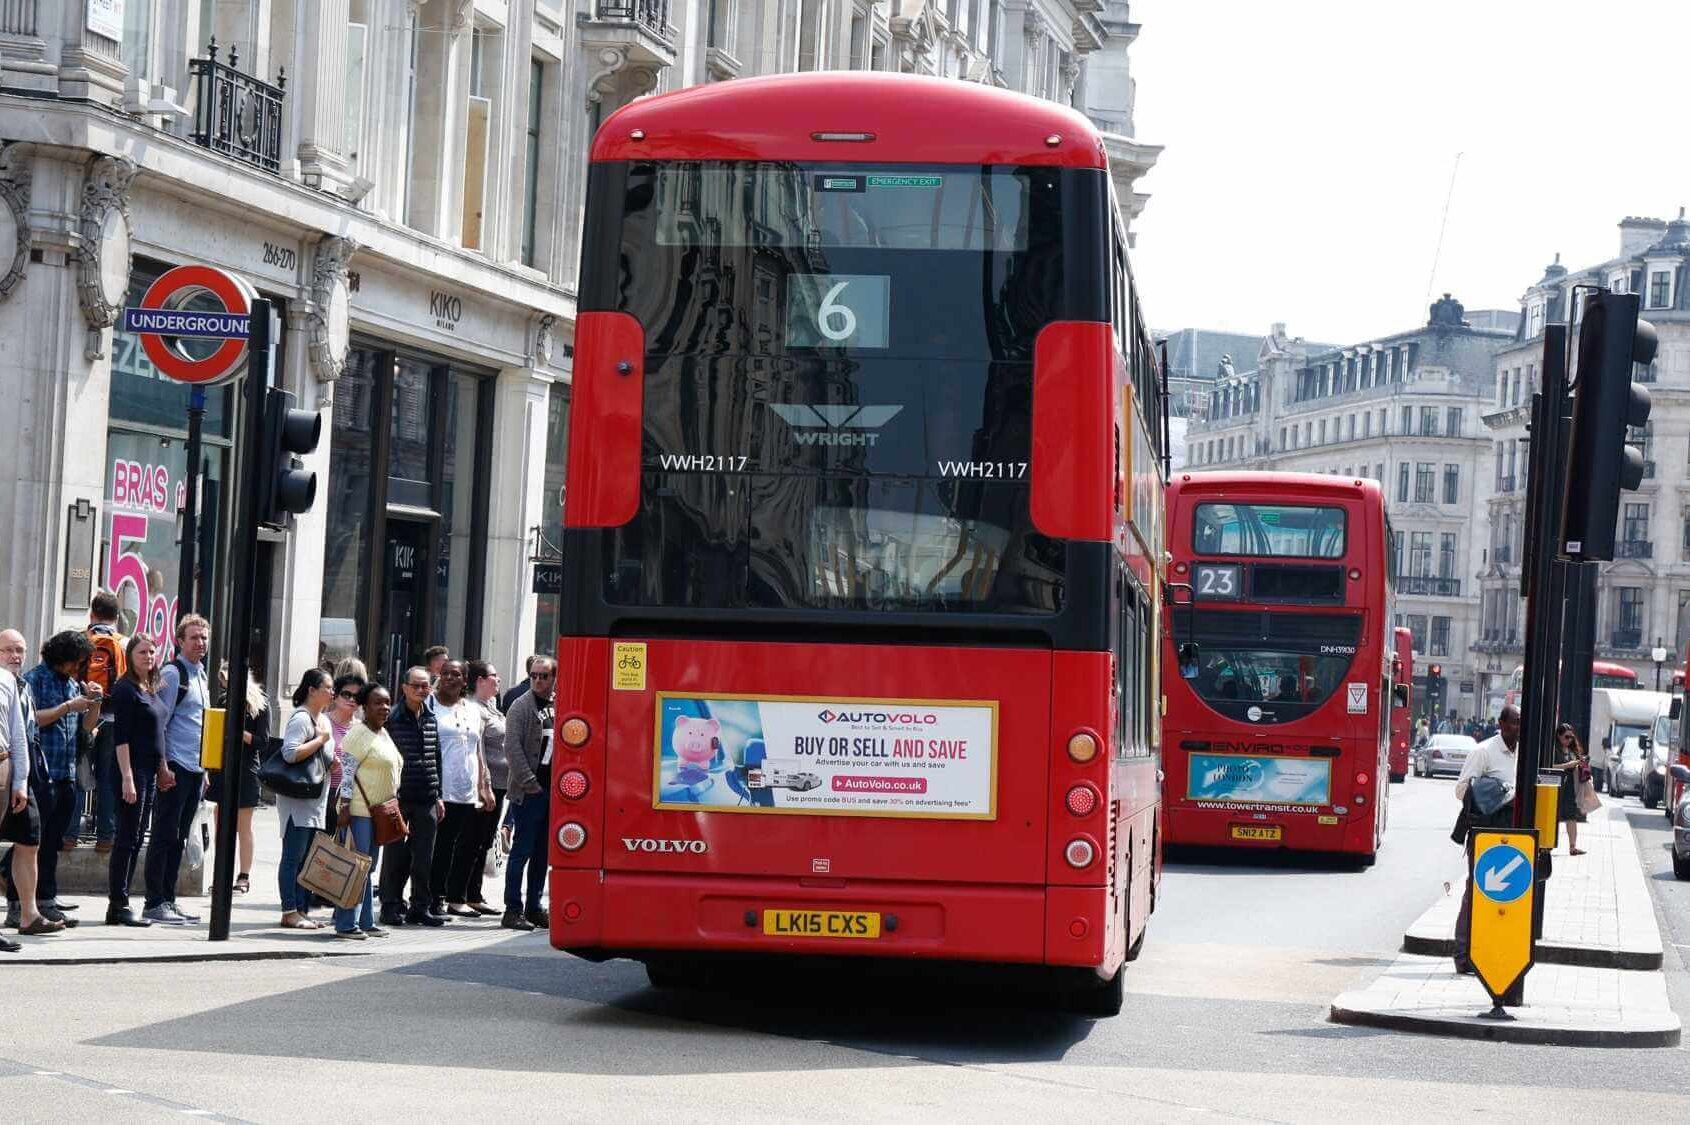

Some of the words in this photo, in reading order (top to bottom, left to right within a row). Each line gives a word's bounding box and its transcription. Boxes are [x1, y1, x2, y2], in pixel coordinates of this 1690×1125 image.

[871, 177, 917, 186] EMERGENCY
[920, 178, 936, 186] EXIT
[263, 242, 296, 271] 266-270
[430, 290, 462, 322] KIKO
[818, 281, 857, 341] 6
[794, 432, 880, 447] WRIGHT
[660, 454, 748, 471] VWH2117
[937, 460, 1028, 479] VWH2117
[112, 458, 169, 514] BRAS
[1201, 569, 1233, 594] 23
[836, 712, 937, 724] AUTOVOLO
[795, 736, 824, 756] BUY
[829, 737, 849, 757] OR
[852, 738, 889, 758] SELL
[892, 739, 924, 758] AND
[928, 740, 968, 760] SAVE
[815, 758, 850, 766] Advertise
[852, 760, 869, 768] your
[912, 760, 926, 768] and
[844, 779, 922, 790] AutoVolo.co.uk
[915, 799, 953, 807] advertising
[1197, 801, 1319, 814] www.towertransit.co.uk
[1237, 827, 1257, 837] SN12
[1258, 828, 1276, 838] ATZ
[621, 838, 707, 854] VOLVO
[775, 911, 821, 932] LK15
[827, 913, 868, 934] CXS
